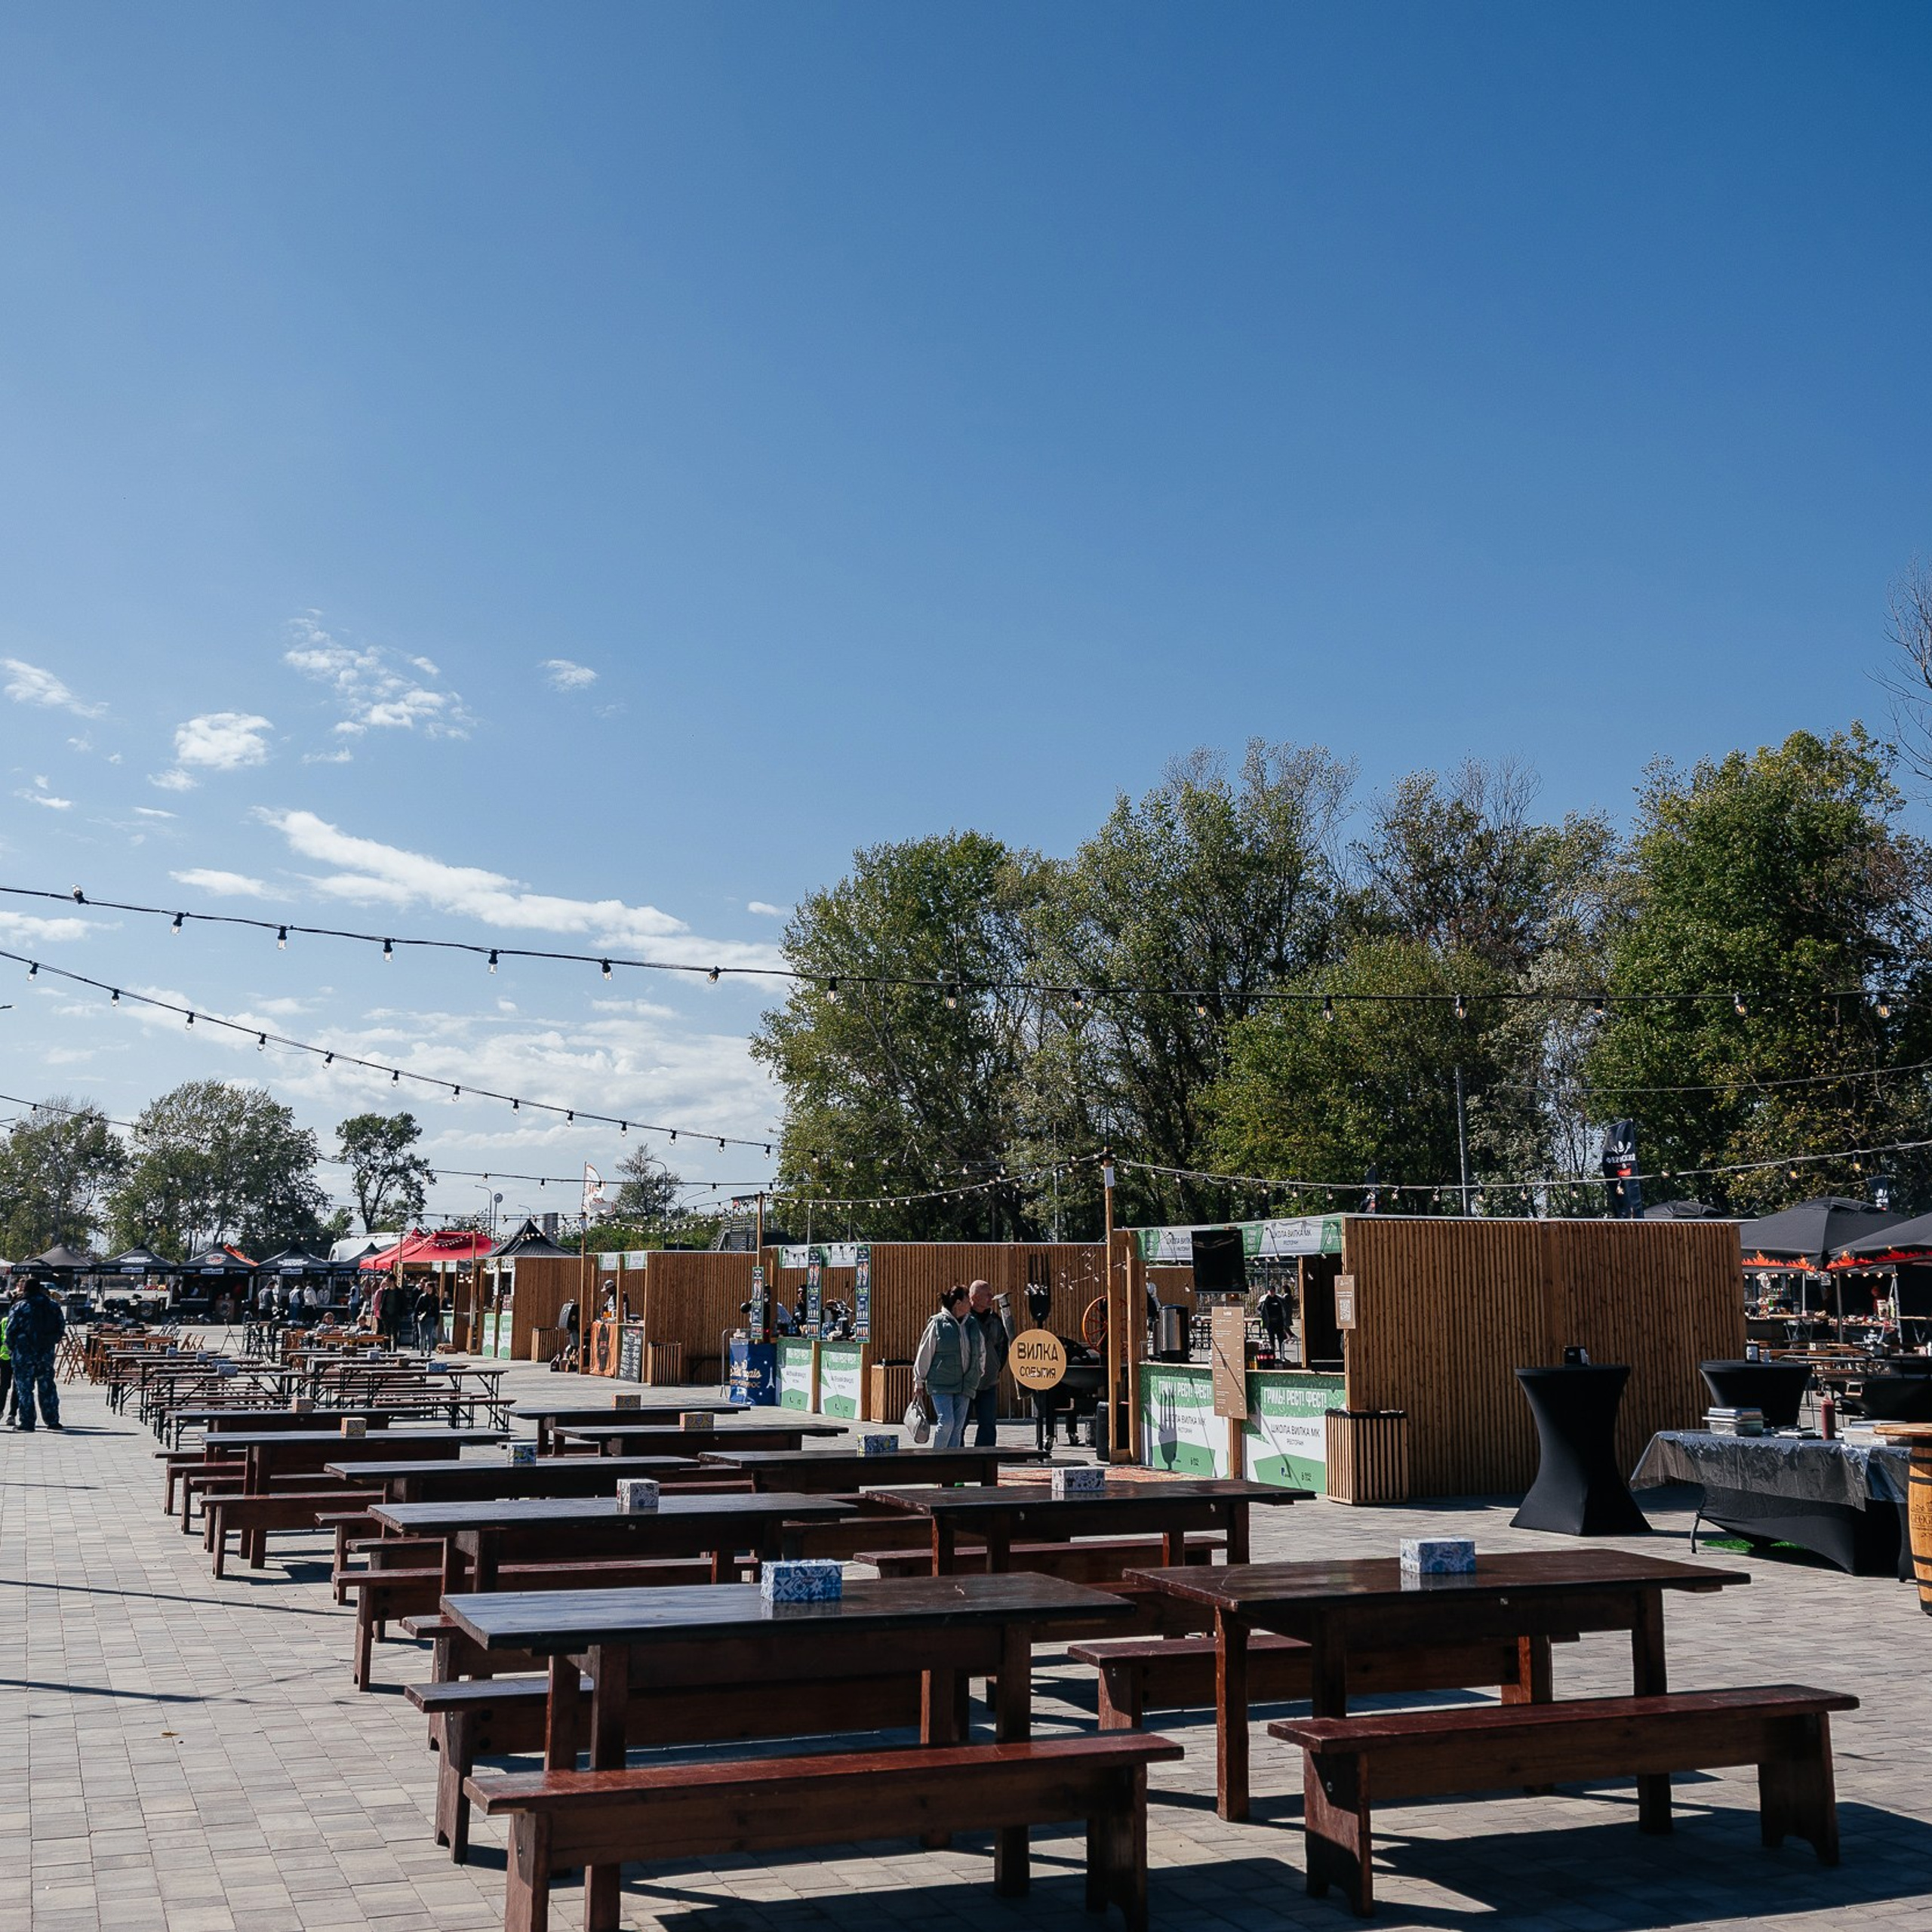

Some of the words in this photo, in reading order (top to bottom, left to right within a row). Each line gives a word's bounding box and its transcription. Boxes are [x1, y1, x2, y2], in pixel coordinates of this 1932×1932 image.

[1017, 1342, 1059, 1361] ВИЛКА
[1019, 1365, 1056, 1379] СОБЫТИЯ
[1177, 1383, 1193, 1398] РЕСТ!
[1195, 1384, 1212, 1399] ФЕСТ!
[1264, 1388, 1285, 1404] ГРИЛЬ!
[1287, 1389, 1305, 1407] РЕСТ!
[1306, 1392, 1327, 1408] ФЕСТ!
[1271, 1423, 1291, 1434] ШКОЛА
[1291, 1426, 1310, 1436] ВИЛКА
[1311, 1429, 1321, 1438] МК
